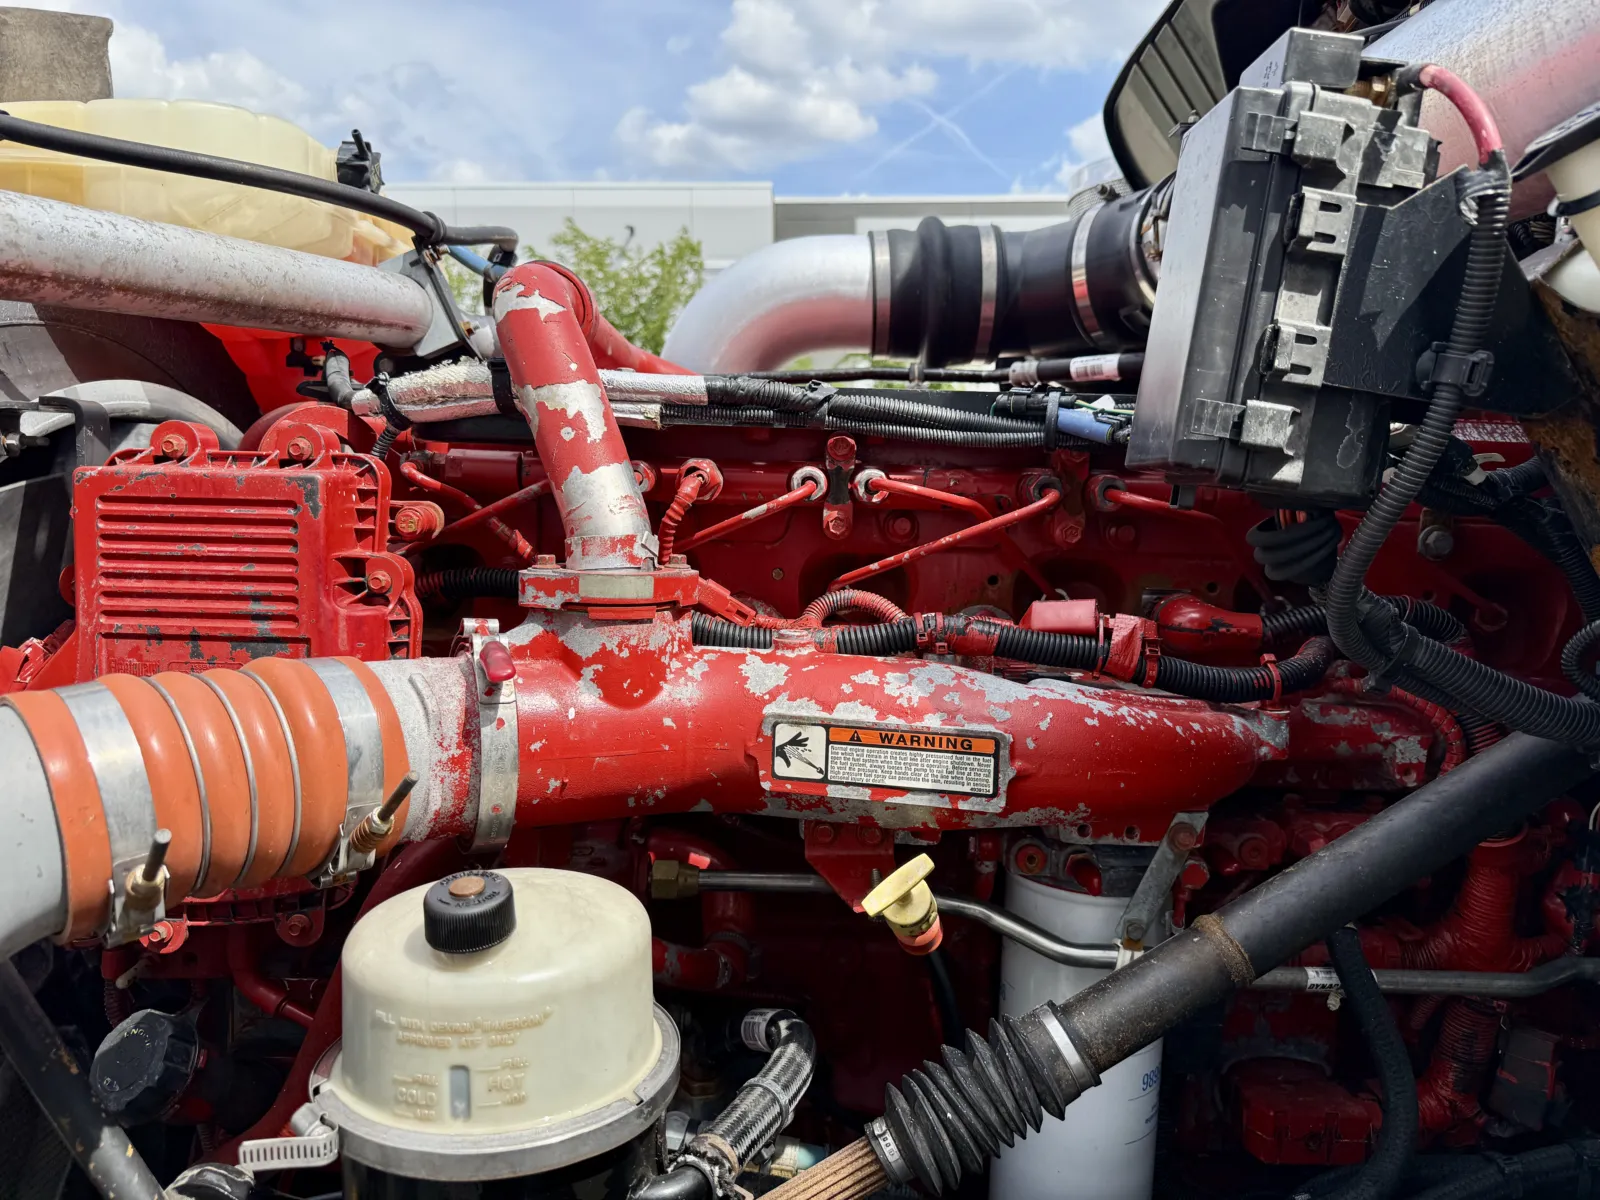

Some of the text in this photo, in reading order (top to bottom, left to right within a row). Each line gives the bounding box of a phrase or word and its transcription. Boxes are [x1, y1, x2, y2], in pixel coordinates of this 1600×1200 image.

[879, 732, 973, 751] WARNING
[398, 1030, 452, 1048] APPROVED
[488, 1031, 521, 1048] ONLY
[487, 1072, 525, 1091] HOT
[1142, 1066, 1160, 1091] 989
[397, 1086, 437, 1106] COLD
